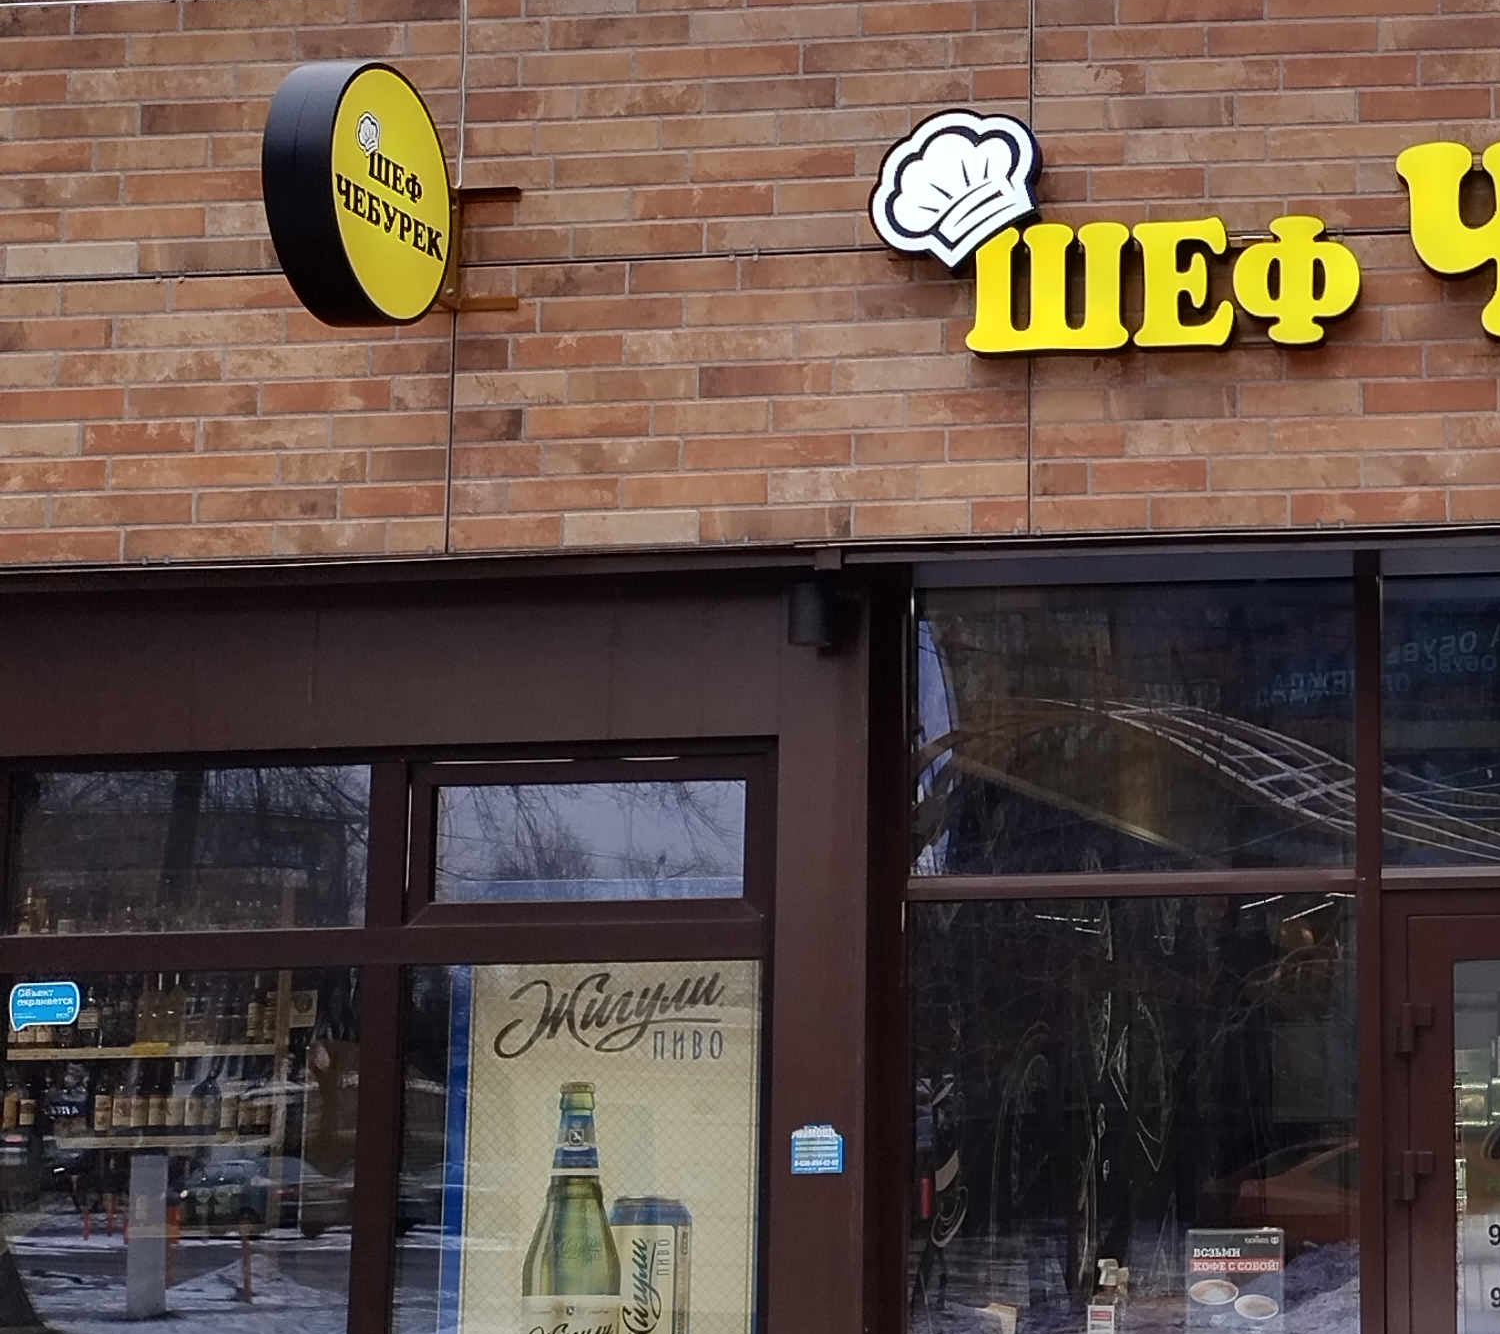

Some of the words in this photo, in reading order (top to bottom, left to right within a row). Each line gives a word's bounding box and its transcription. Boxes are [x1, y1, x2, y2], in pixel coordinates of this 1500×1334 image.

[368, 152, 424, 204] ШЕФ
[335, 173, 444, 262] ЧЕБУРЕК
[964, 214, 1362, 354] ШЕФ
[494, 971, 726, 1059] Жигули
[652, 1029, 724, 1061] ПИВО
[1193, 1247, 1241, 1258] ВОЗЬМИ
[1193, 1261, 1226, 1271] КОФЕ
